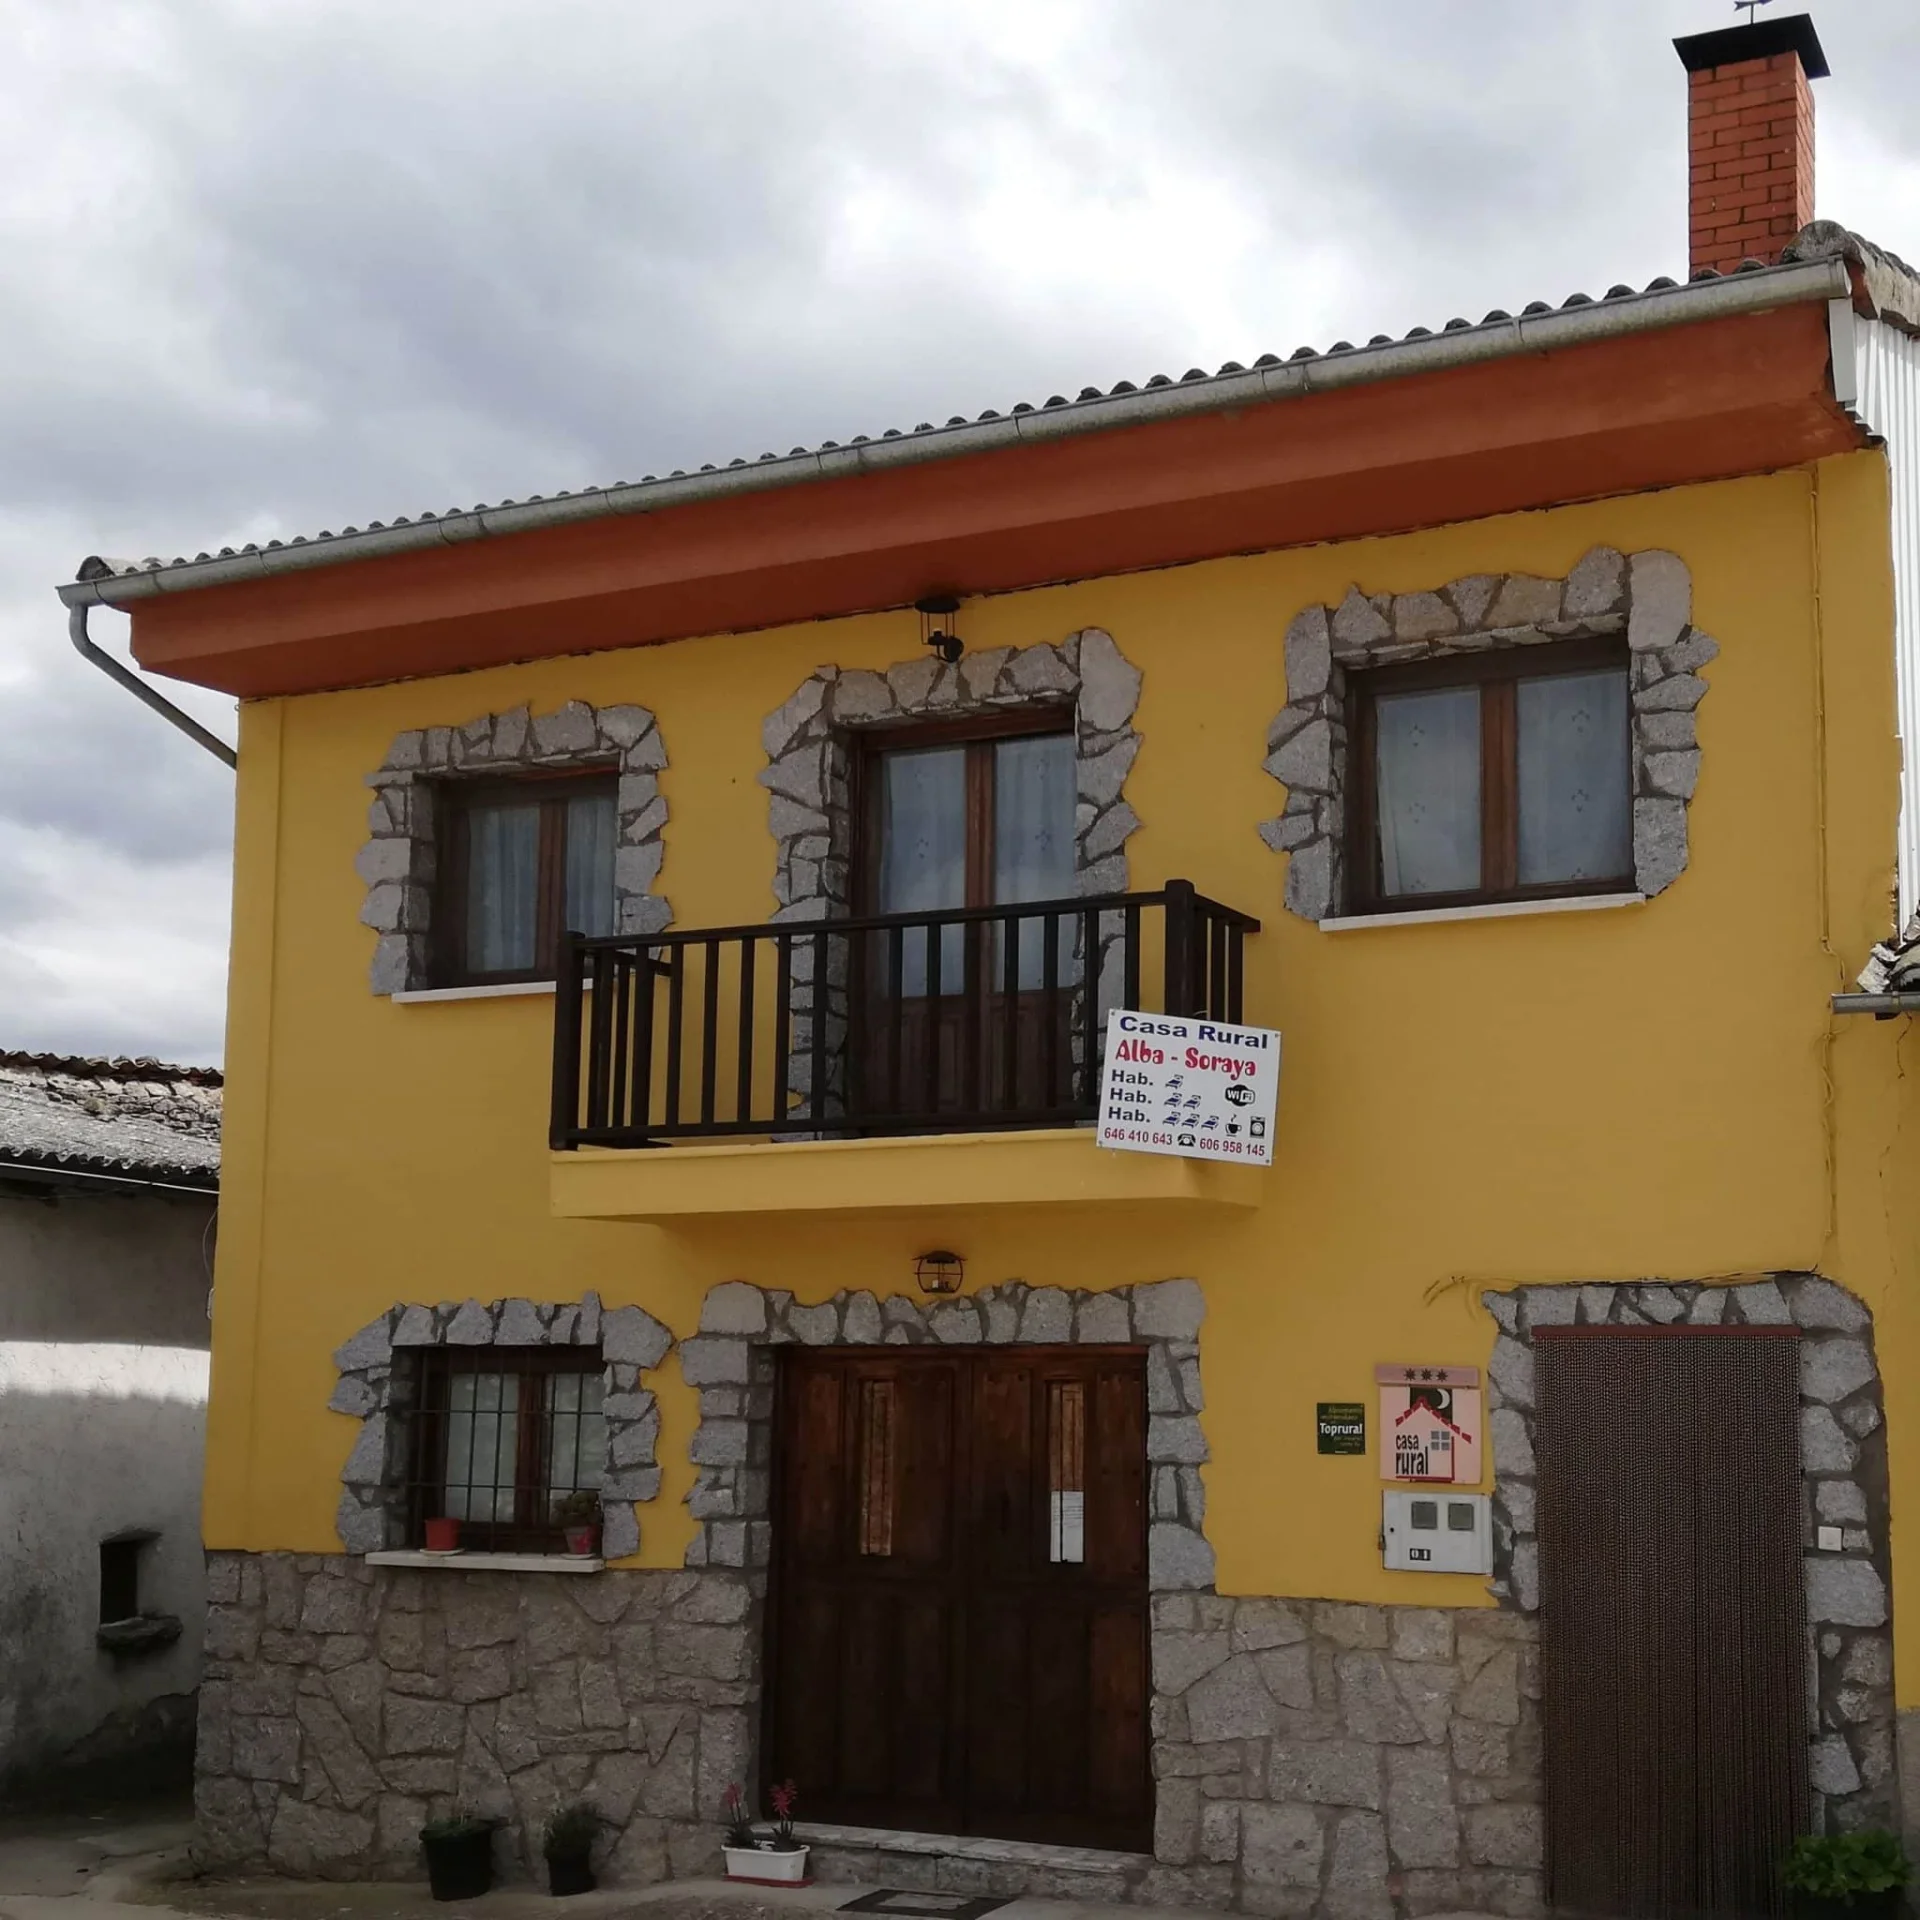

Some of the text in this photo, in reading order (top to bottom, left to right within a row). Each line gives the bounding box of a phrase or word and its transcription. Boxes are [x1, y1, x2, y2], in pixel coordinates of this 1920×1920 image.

[1119, 1016, 1268, 1049] Casa Rural
[1115, 1039, 1164, 1065] Alba
[1185, 1047, 1256, 1081] Soraya
[1111, 1069, 1154, 1086] Hab.
[1110, 1087, 1152, 1104] Hab.
[1108, 1106, 1151, 1123] Hab.
[1104, 1127, 1173, 1145] 646 410 643
[1199, 1138, 1265, 1157] 606 958 145
[1319, 1422, 1363, 1437] Toprural
[1395, 1434, 1419, 1450] casa
[1395, 1446, 1429, 1475] rural
